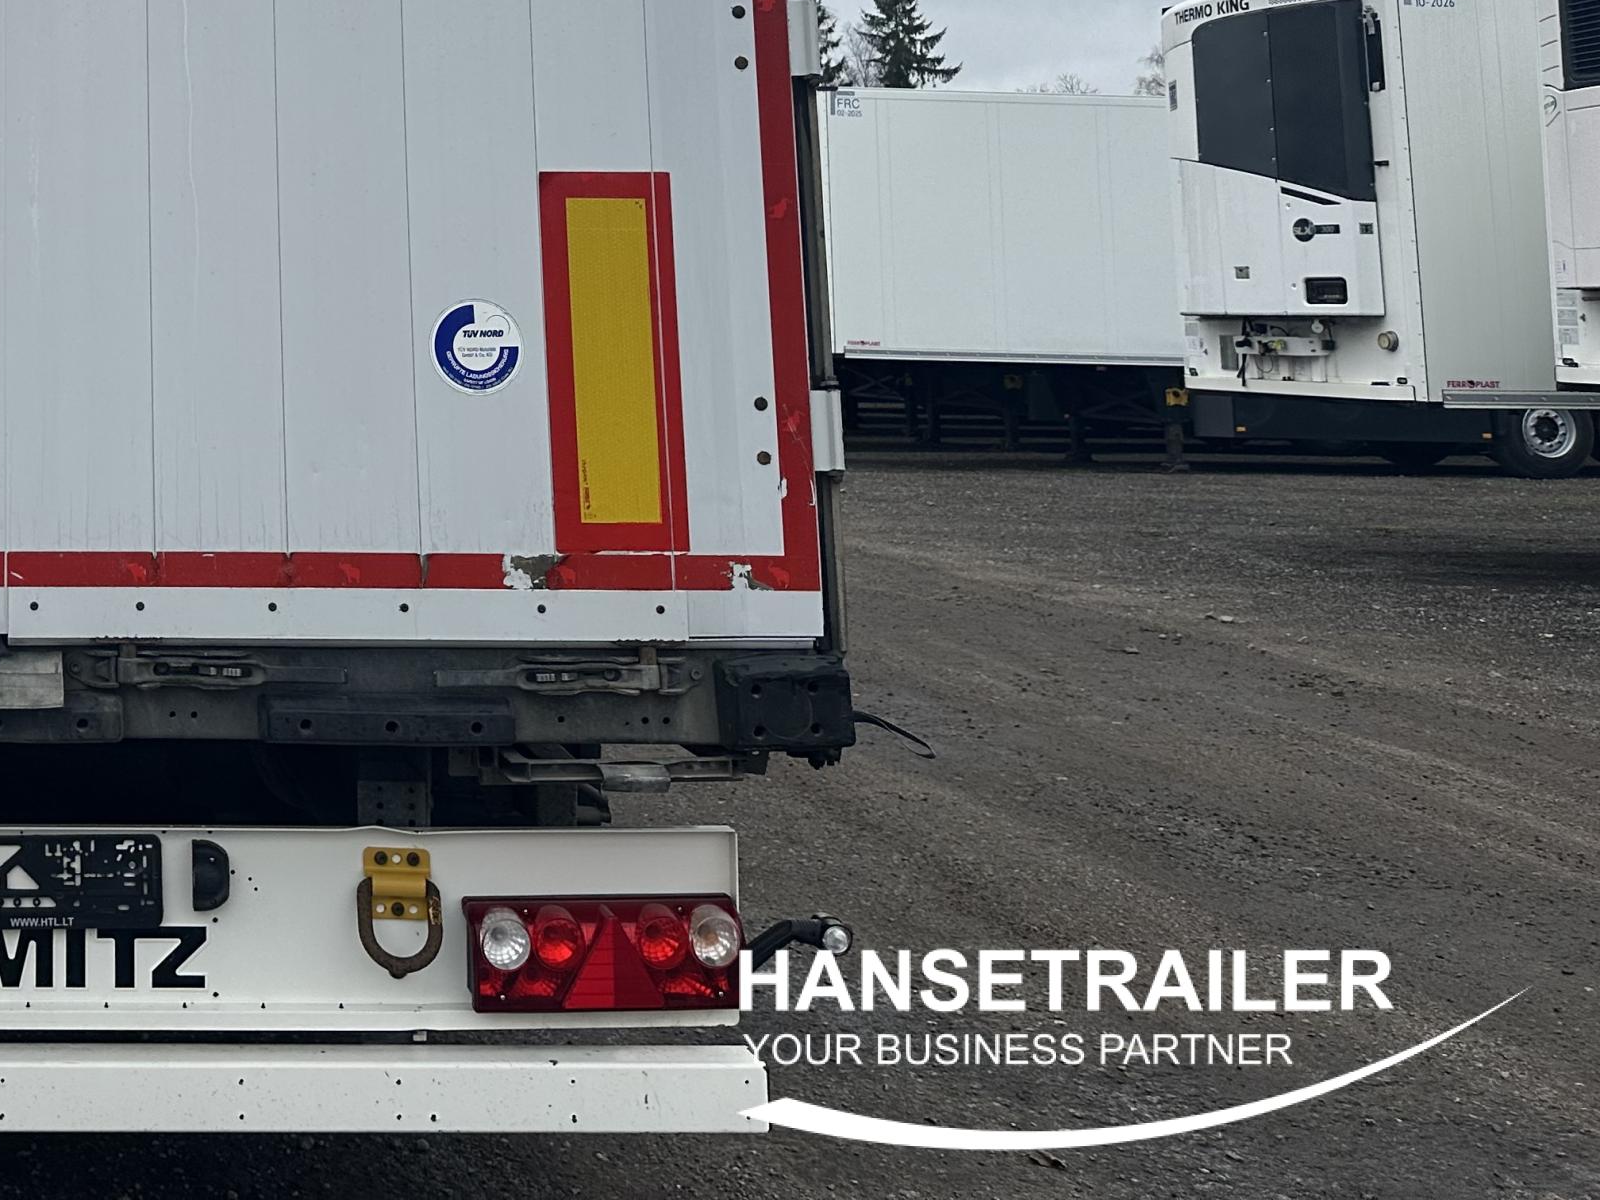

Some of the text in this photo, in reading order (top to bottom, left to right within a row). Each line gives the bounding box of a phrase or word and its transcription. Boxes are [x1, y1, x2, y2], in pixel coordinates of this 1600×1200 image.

[1174, 3, 1213, 25] THERMO
[836, 98, 860, 109] FRC
[10, 917, 74, 927] WWW.HTL.LT
